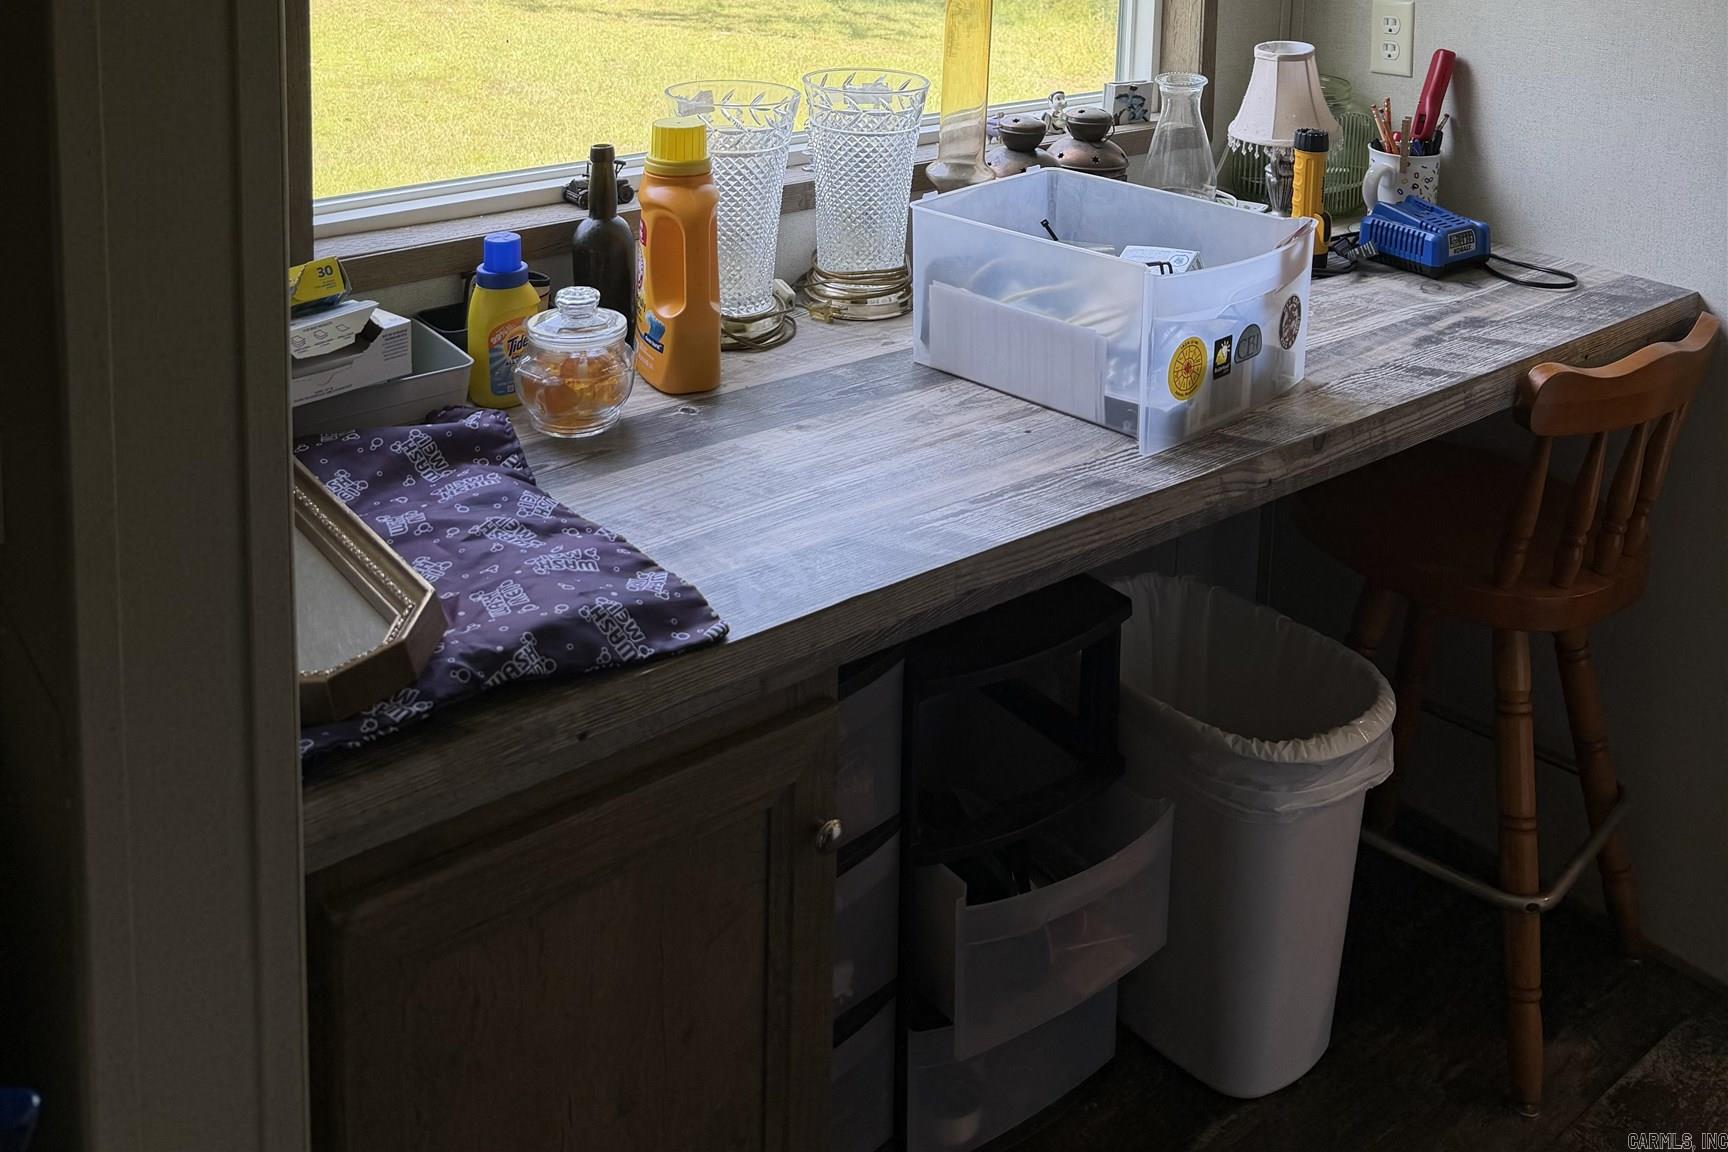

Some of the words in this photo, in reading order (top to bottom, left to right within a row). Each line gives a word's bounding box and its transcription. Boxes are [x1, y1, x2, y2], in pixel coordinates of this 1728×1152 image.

[316, 265, 333, 278] 30
[507, 334, 529, 356] Tide
[400, 439, 443, 482] WASH
[589, 604, 639, 662] WASH
